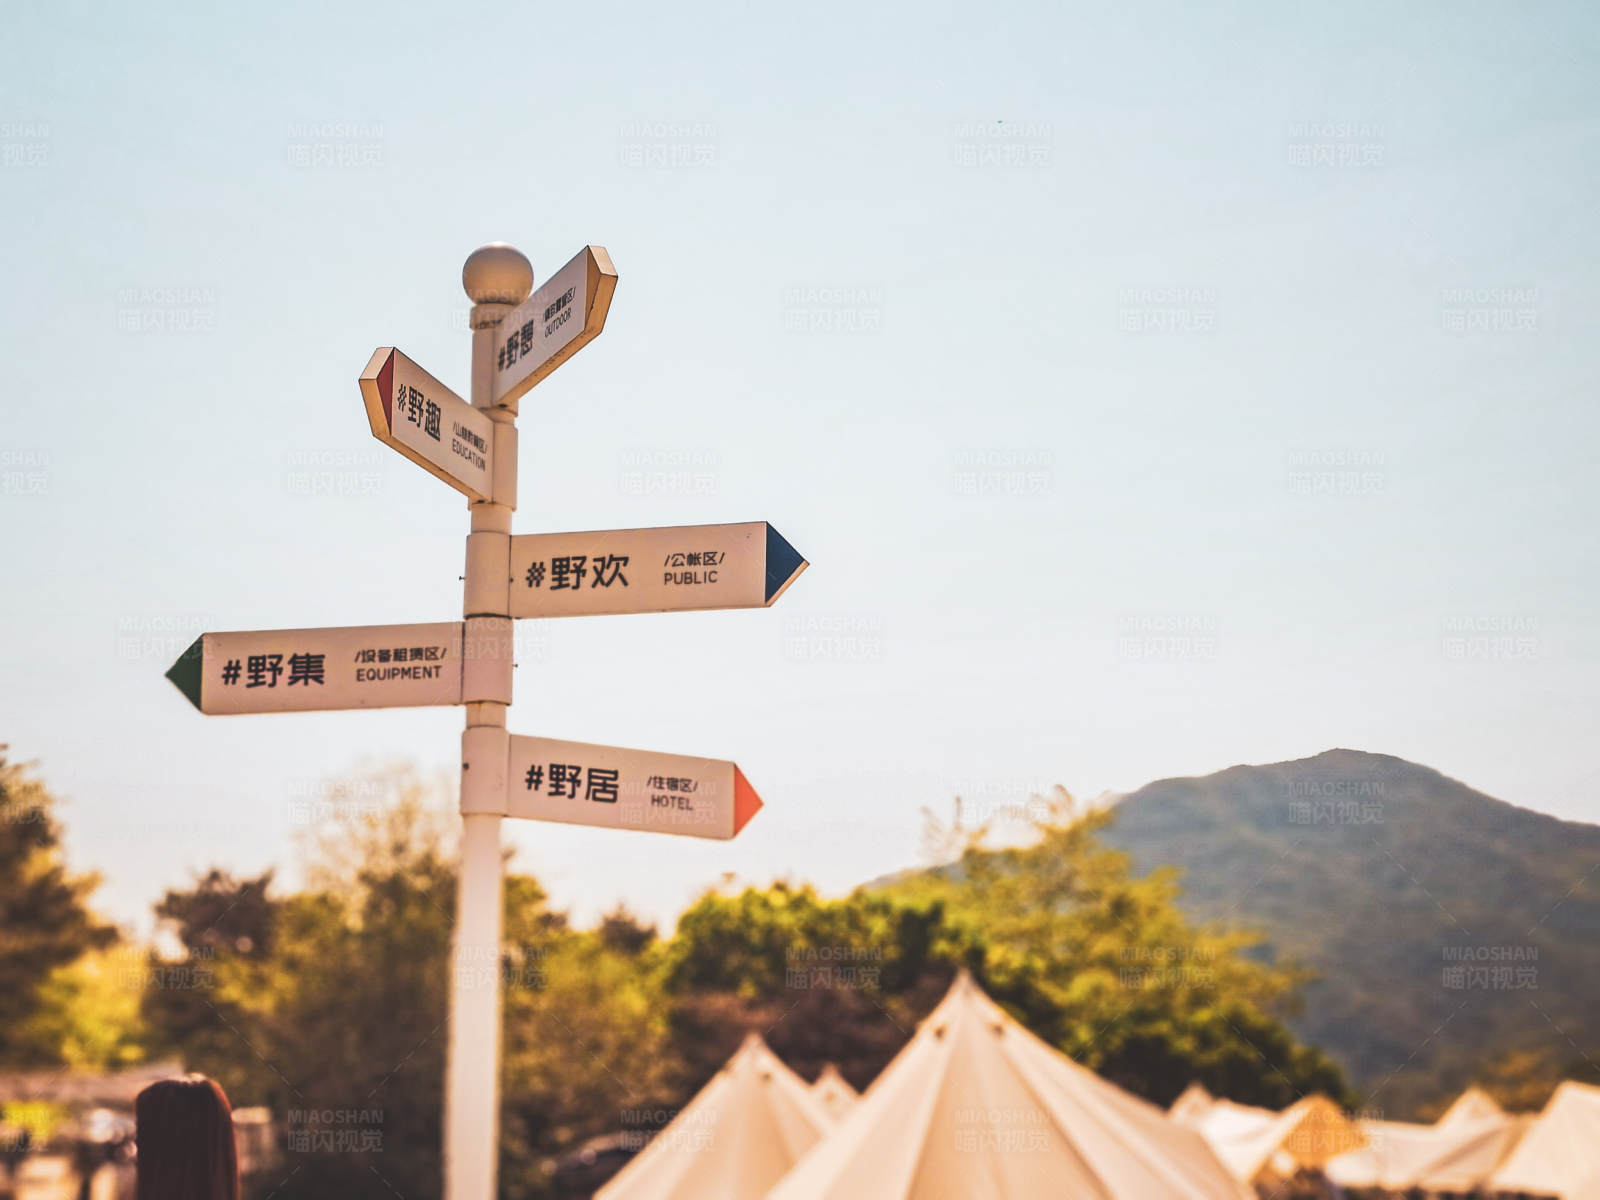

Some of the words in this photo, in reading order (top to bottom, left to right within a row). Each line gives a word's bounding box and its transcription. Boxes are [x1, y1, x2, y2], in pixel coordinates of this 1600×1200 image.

[544, 307, 572, 338] OUTDOOR
[397, 383, 442, 442] #野趣
[452, 438, 487, 472] EDUCATION
[524, 553, 630, 591] #野欢
[664, 570, 719, 586] PUBLIC
[221, 652, 327, 689] #野集
[356, 665, 442, 682] EQUIPMENT
[524, 763, 620, 804] #野居
[651, 794, 694, 811] HOTEL
